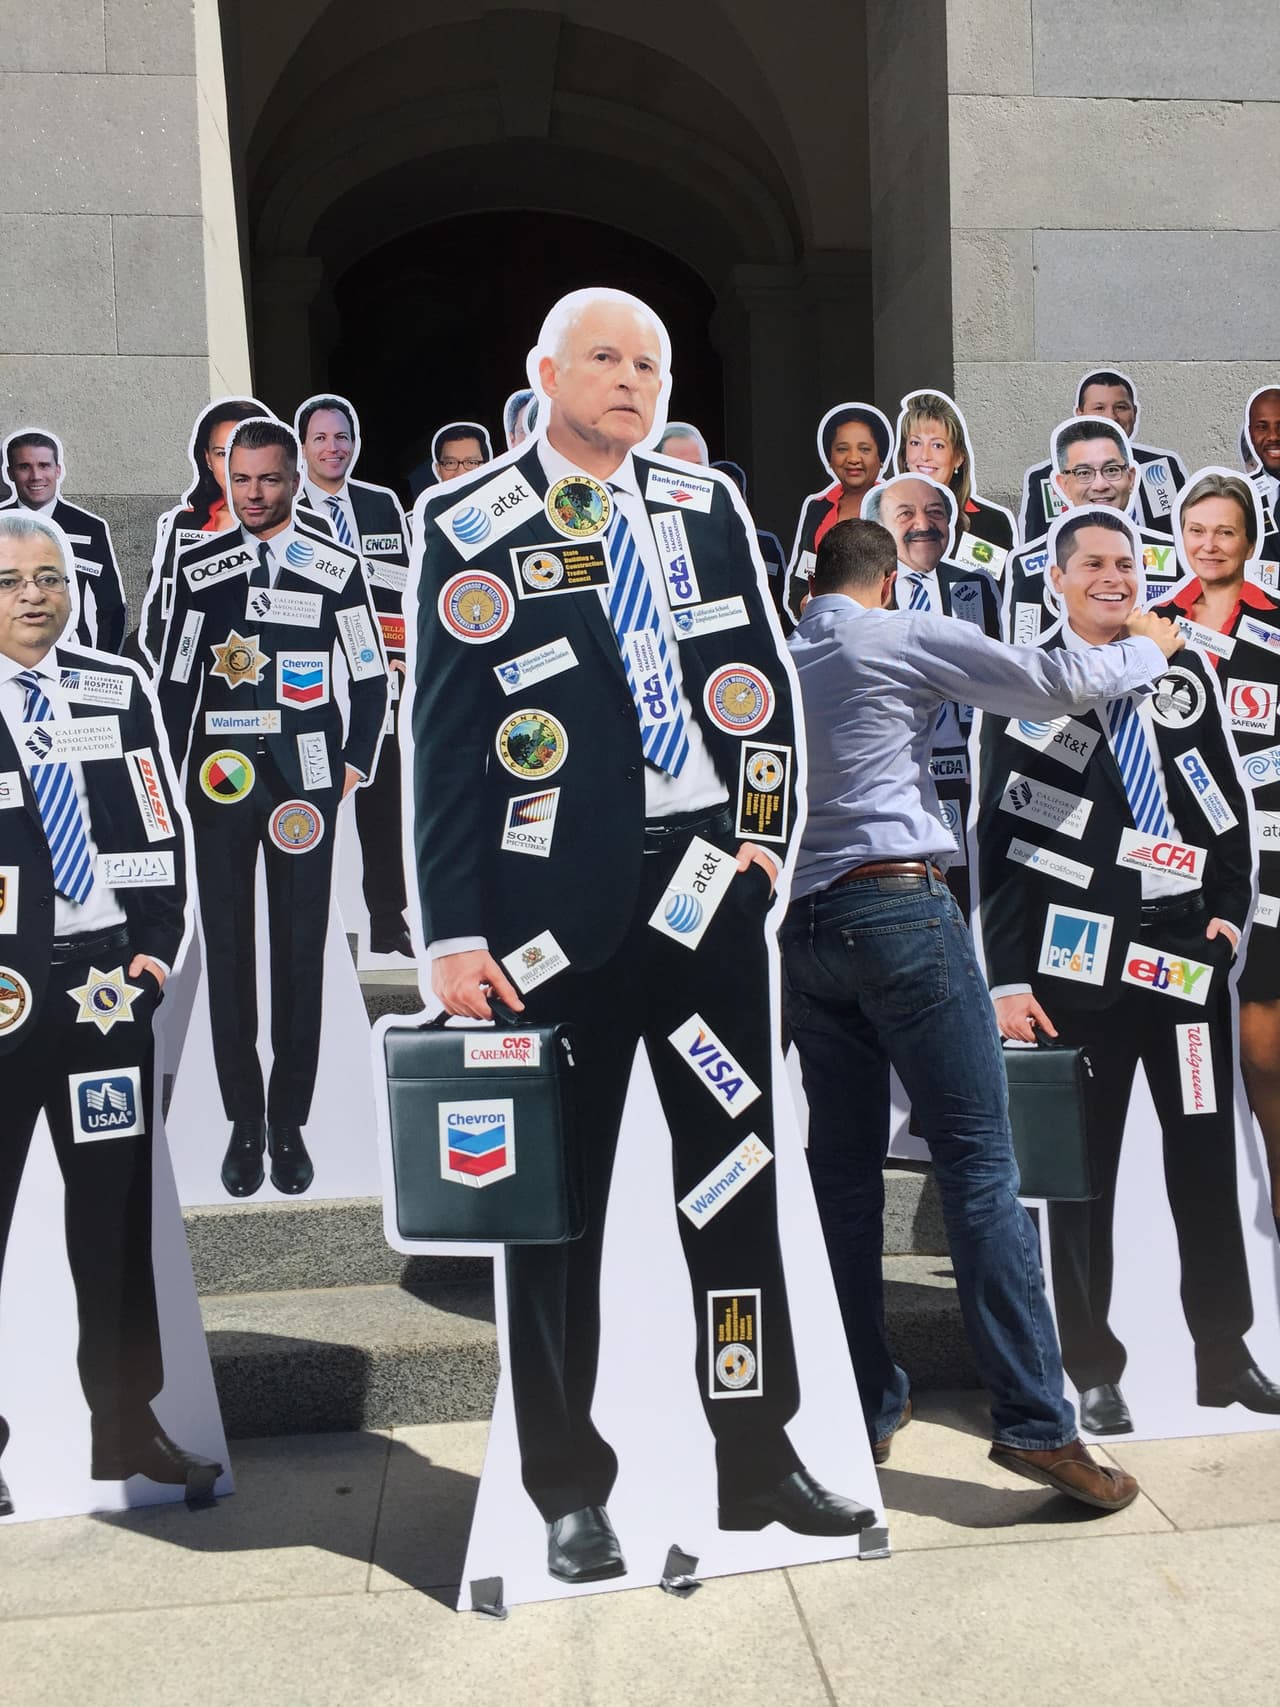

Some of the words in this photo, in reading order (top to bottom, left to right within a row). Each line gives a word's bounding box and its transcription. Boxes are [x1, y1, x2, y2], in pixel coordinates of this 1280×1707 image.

[490, 483, 530, 518] at&t
[1156, 487, 1172, 511] at&t
[180, 532, 204, 540] LOCAL
[660, 521, 671, 553] CALIFORNIA
[668, 526, 677, 552] TEACHERS
[672, 514, 683, 551] ASSOCIATION
[365, 538, 399, 551] CNCDA
[190, 551, 253, 582] OCADA
[565, 561, 604, 570] Construction
[960, 556, 977, 568] JOHN
[1025, 554, 1048, 571] CT
[1143, 546, 1173, 571] aY
[315, 559, 347, 580] at&t
[568, 575, 592, 584] Council
[633, 640, 644, 673] CALIFORNIA
[641, 645, 649, 671] TEACHERS
[644, 633, 657, 670] ASSOCIATION
[282, 659, 324, 669] Chevron
[353, 656, 363, 672] LLC
[84, 680, 123, 691] HOSPITAL
[55, 726, 112, 737] CALIFORNIA
[211, 716, 260, 728] Walmart
[1231, 718, 1268, 730] SAFEWAY
[55, 735, 114, 745] ASSOCIATION
[1053, 730, 1089, 757] at&t
[931, 758, 964, 776] NCDA
[1182, 754, 1210, 796] CTA
[140, 758, 170, 834] BNSF
[1031, 805, 1041, 813] OF
[506, 831, 548, 845] SONY
[1262, 824, 1280, 837] at
[505, 838, 547, 852] PICTURES
[1013, 847, 1032, 859] blue
[1039, 857, 1049, 866] of
[1049, 862, 1086, 881] california
[1151, 842, 1197, 874] CFA
[692, 852, 722, 894] at&t
[1121, 856, 1148, 868] California
[1167, 866, 1198, 881] Association
[1047, 946, 1095, 973] PG&E
[503, 1037, 532, 1049] CVS
[471, 1049, 530, 1063] CAREMARK
[688, 1026, 744, 1102] VISA
[1186, 1026, 1205, 1111] Walgreens
[88, 1112, 129, 1130] USAA
[447, 1113, 505, 1126] Chevron
[690, 1160, 747, 1214] Walmart
